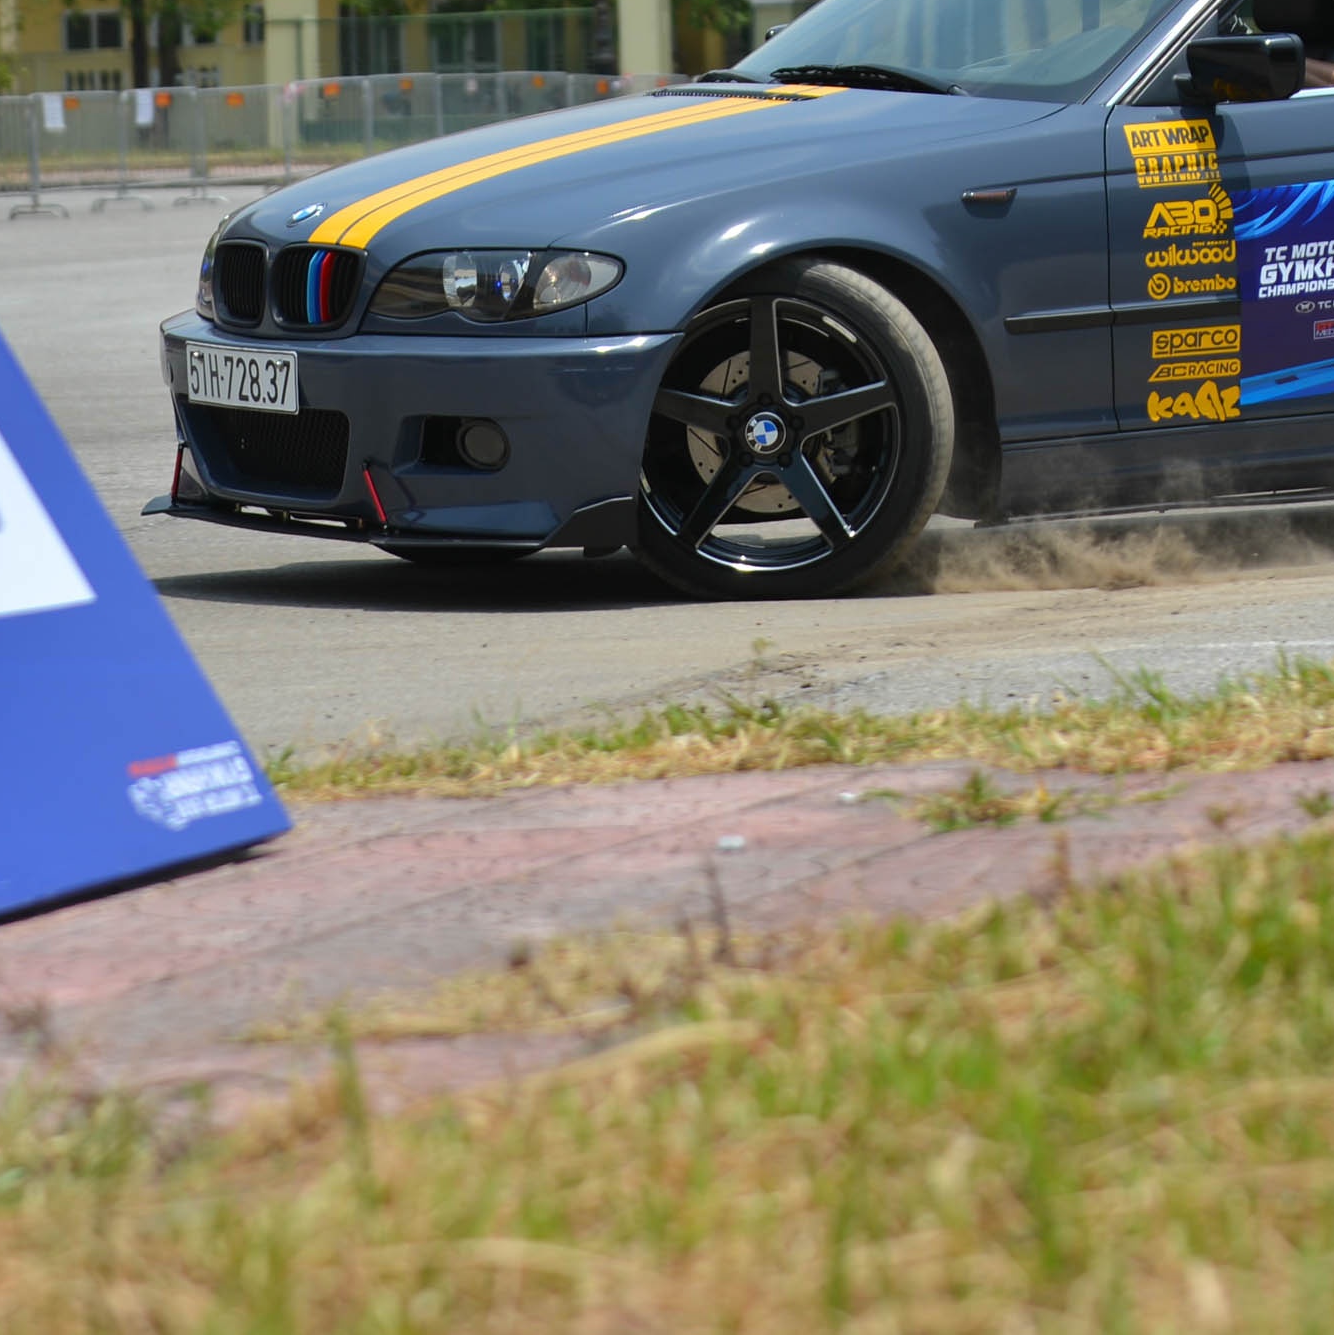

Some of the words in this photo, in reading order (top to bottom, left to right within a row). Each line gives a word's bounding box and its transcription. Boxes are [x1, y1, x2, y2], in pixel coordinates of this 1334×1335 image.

[1130, 130, 1160, 148] ART
[1162, 126, 1209, 145] WRAP
[1135, 153, 1218, 175] GRAPHIC
[1143, 224, 1213, 238] RACING
[1145, 240, 1236, 267] wilwood
[1265, 246, 1288, 263] TC
[1173, 273, 1237, 294] brembo
[1317, 300, 1331, 310] TC
[1155, 329, 1238, 355] sparco
[189, 351, 291, 405] 51H-728.37
